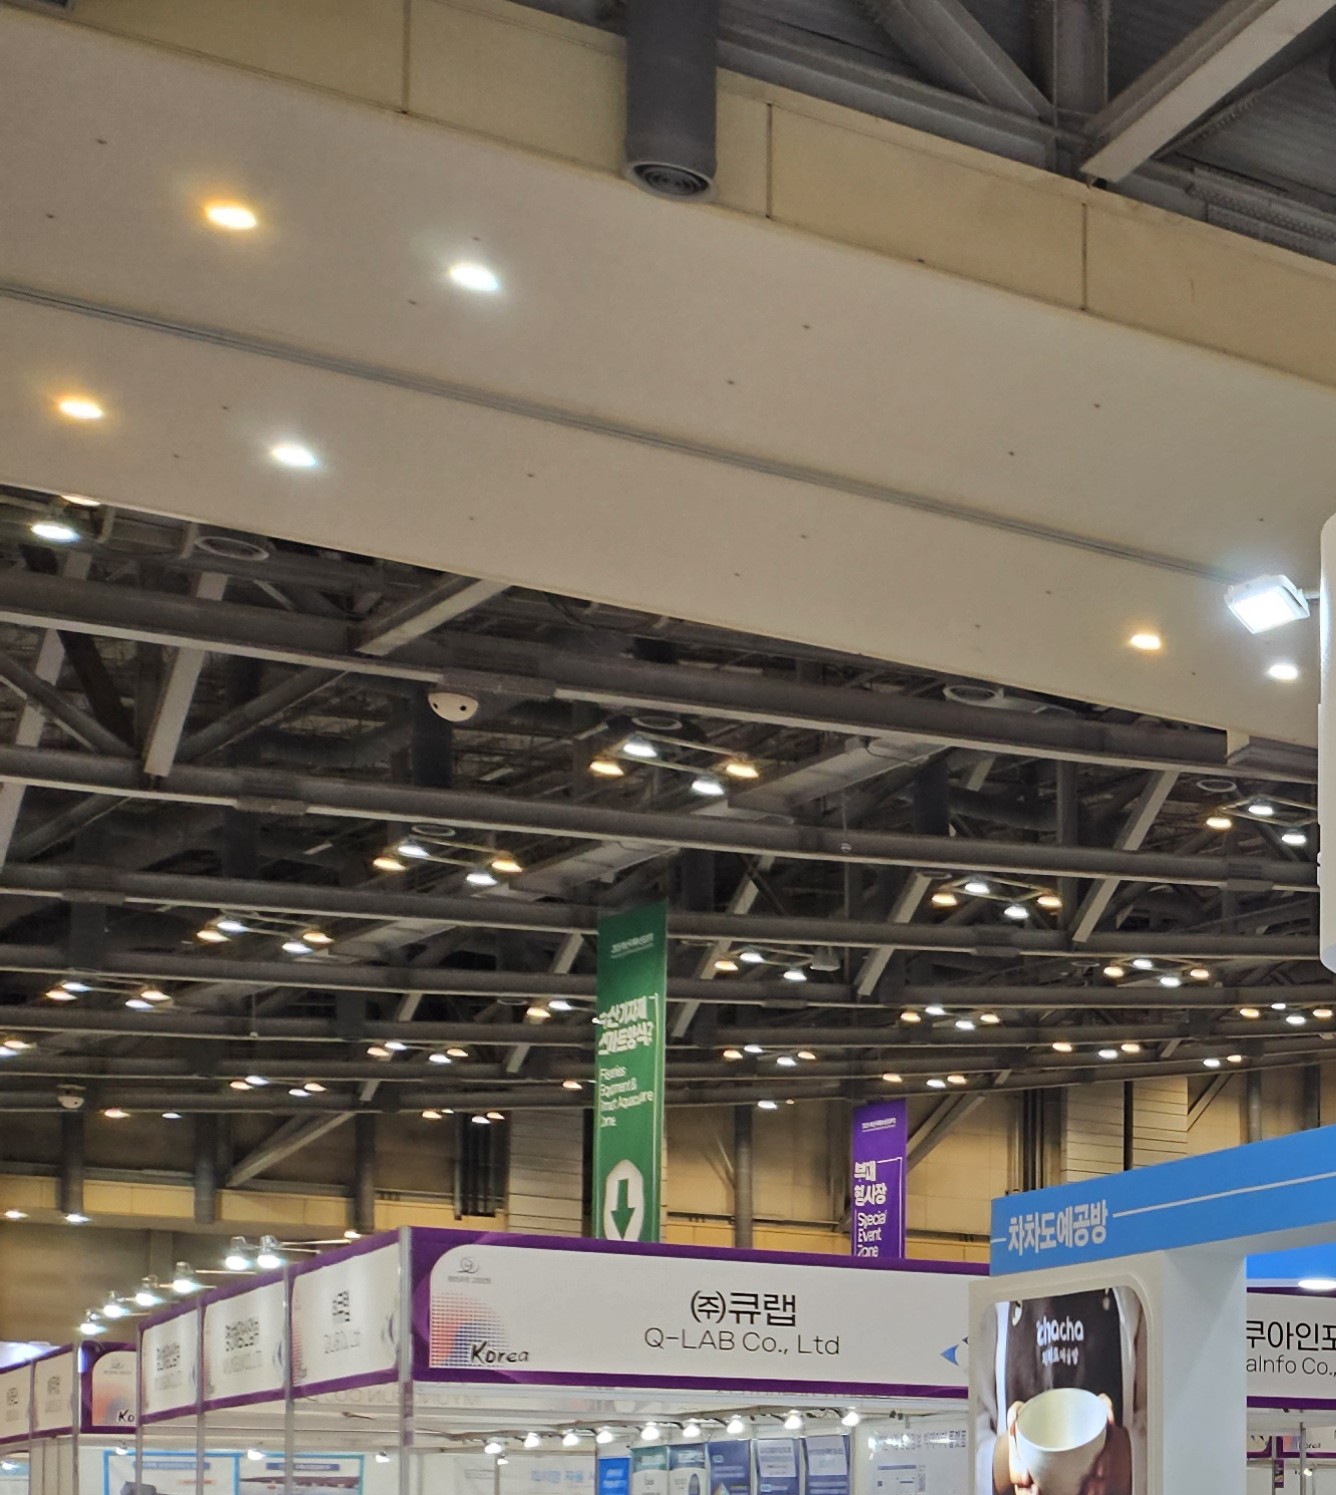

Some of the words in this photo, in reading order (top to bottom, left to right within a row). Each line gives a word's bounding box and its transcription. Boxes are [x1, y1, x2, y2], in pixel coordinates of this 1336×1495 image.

[858, 1227, 882, 1243] Event
[1008, 1199, 1108, 1256] 차차도예공방
[471, 1340, 530, 1364] Korea
[644, 1327, 735, 1350] Q-LAB
[797, 1335, 840, 1355] Ltd
